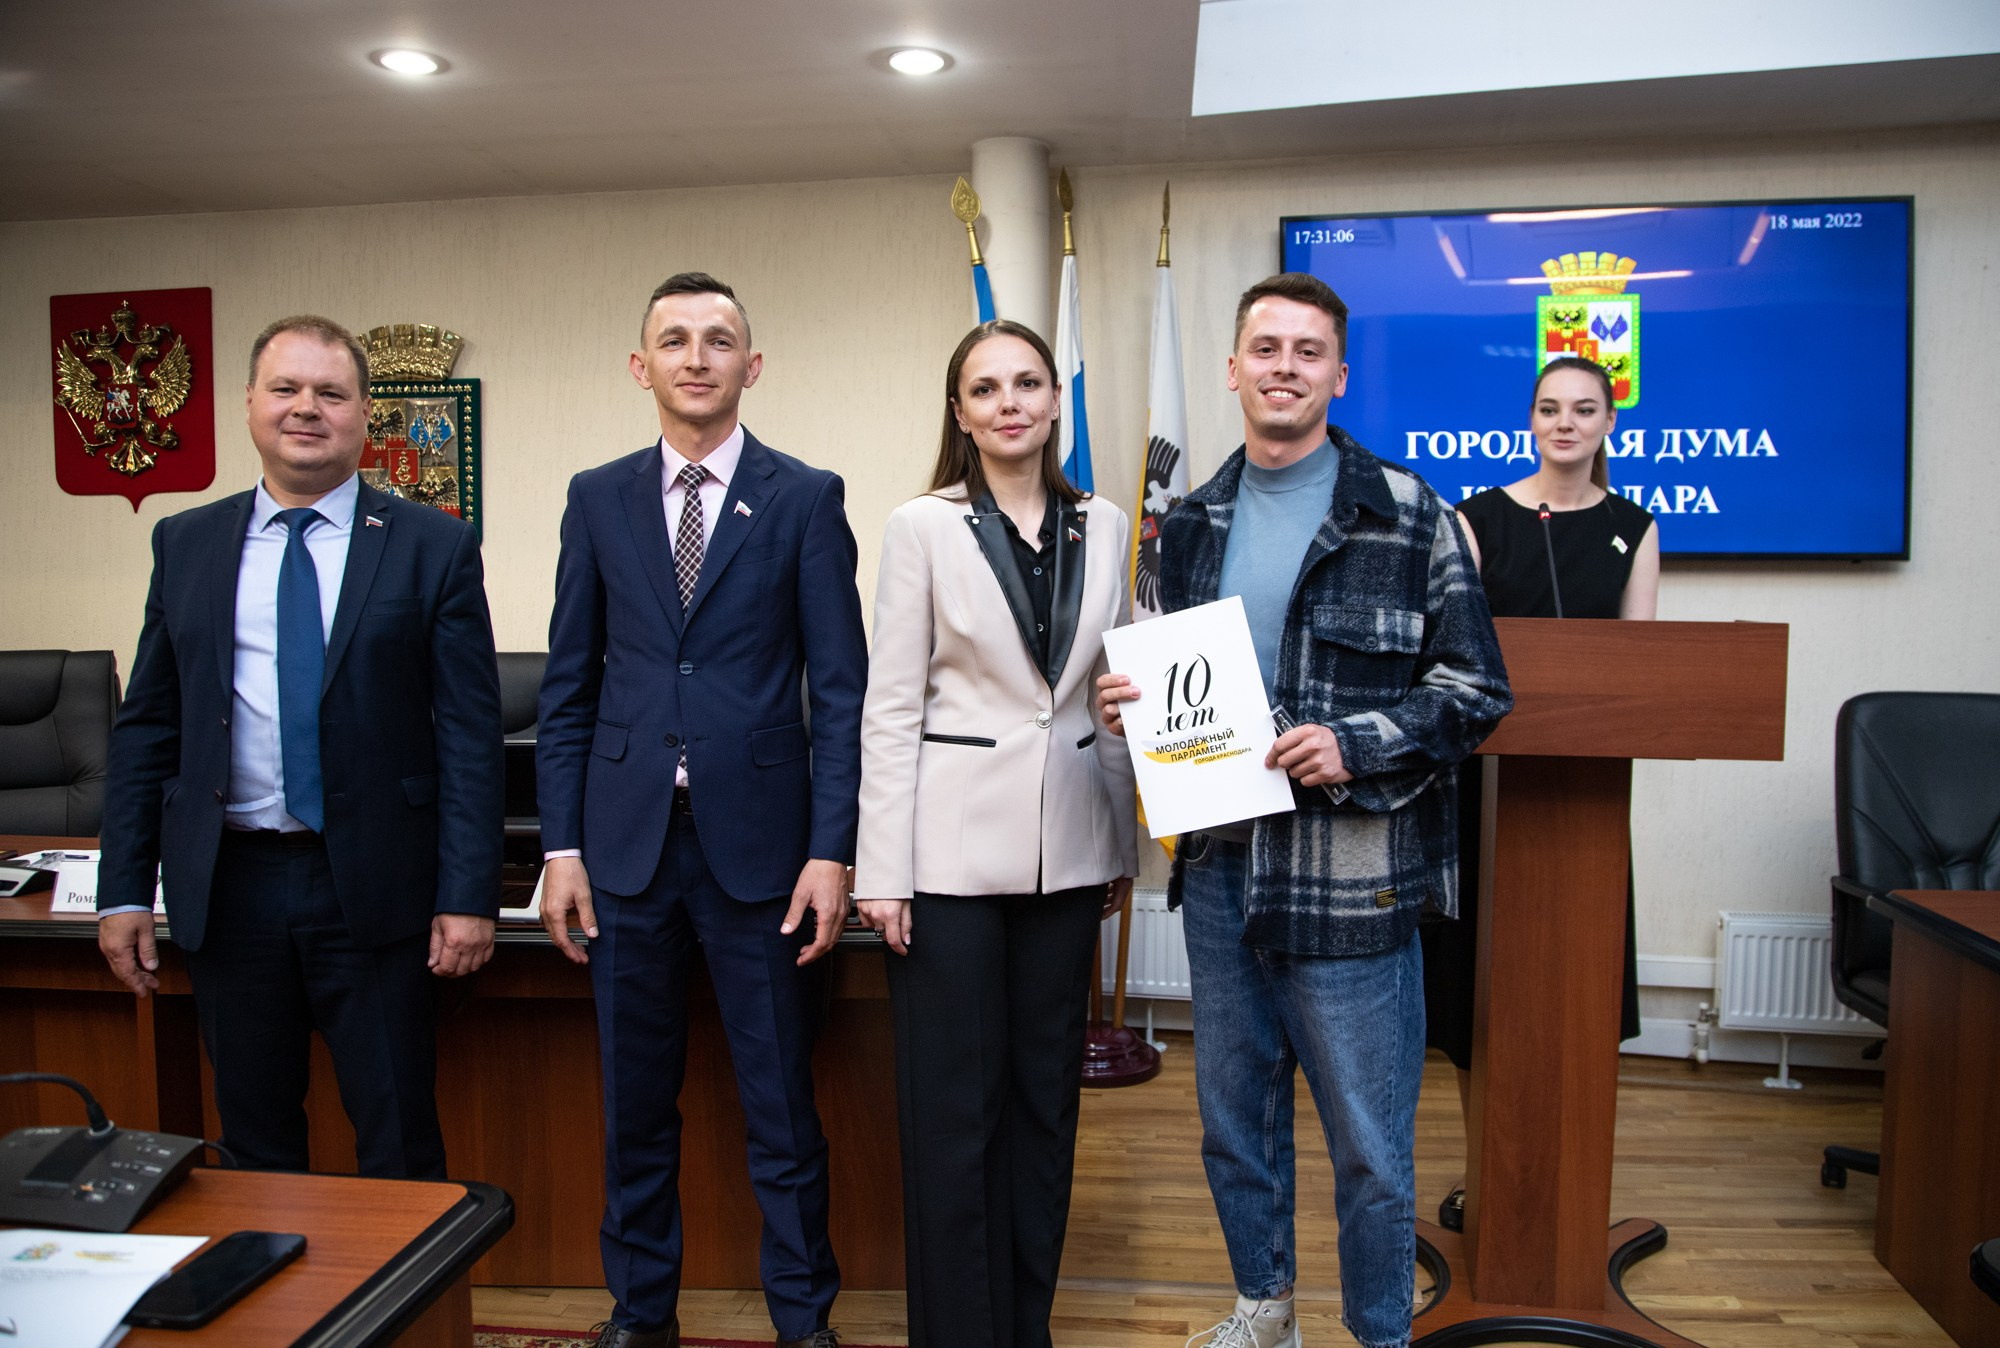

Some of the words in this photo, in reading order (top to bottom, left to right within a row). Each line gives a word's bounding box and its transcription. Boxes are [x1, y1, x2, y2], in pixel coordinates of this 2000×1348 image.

[1771, 214, 1788, 230] 18
[1791, 217, 1821, 229] мая
[1824, 212, 1863, 229] 2022
[1295, 229, 1355, 245] 17:31:06
[1655, 428, 1779, 464] ДУМА
[1164, 652, 1212, 714] 10
[1156, 706, 1219, 736] лет
[1156, 727, 1235, 755] МОЛОДЁЖНЫЙ
[1171, 742, 1227, 762] ПАРЛАМЕНТ
[1195, 755, 1216, 765] ГОРОДА
[1217, 746, 1252, 760] КРАСНОДАРА
